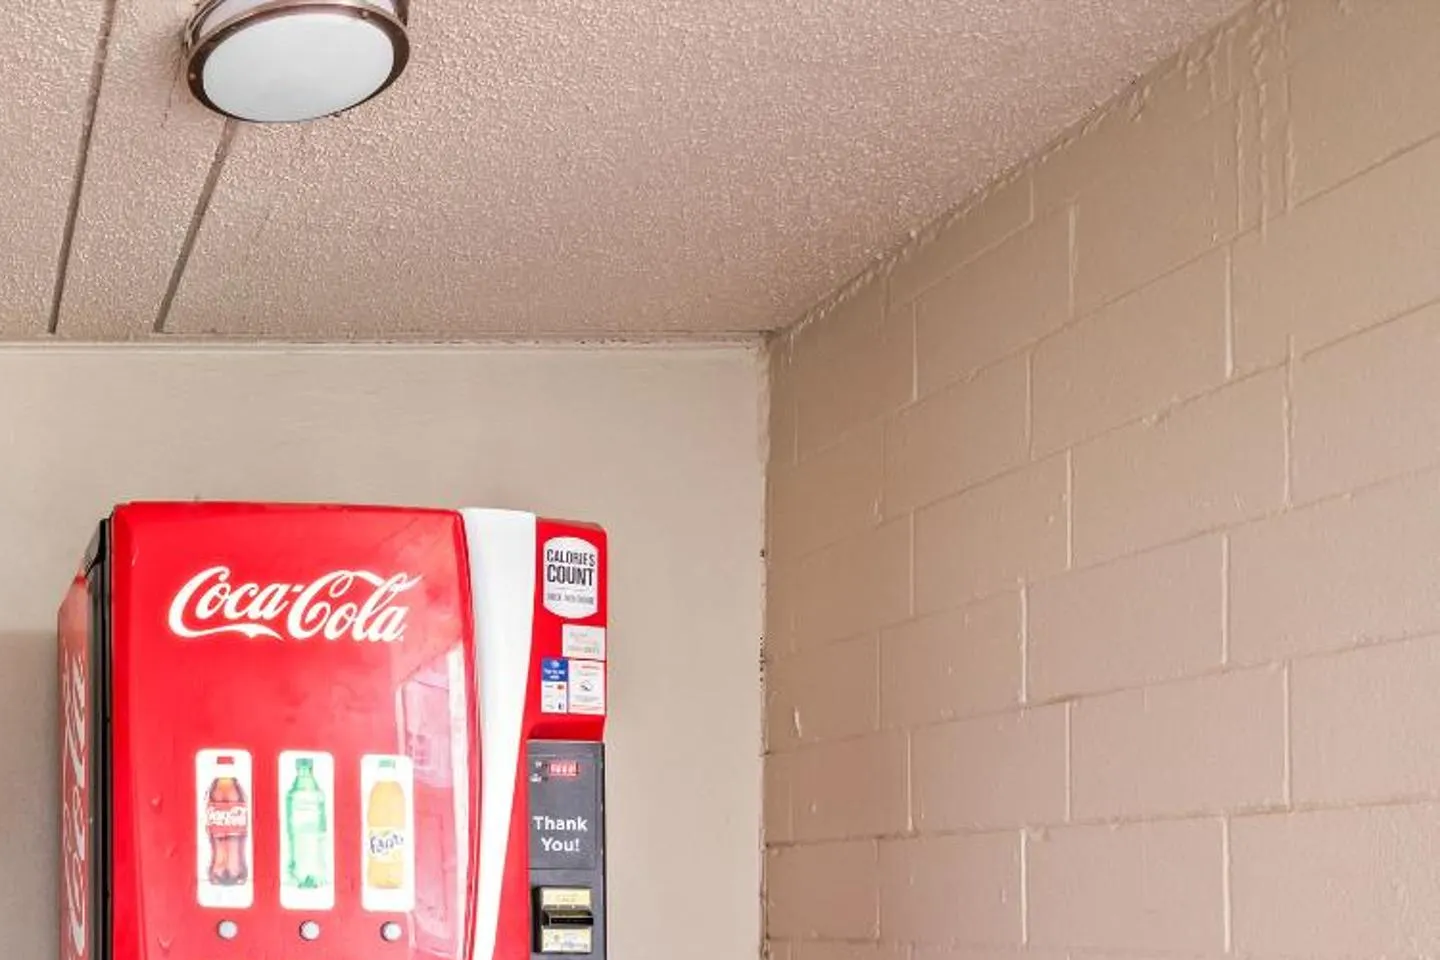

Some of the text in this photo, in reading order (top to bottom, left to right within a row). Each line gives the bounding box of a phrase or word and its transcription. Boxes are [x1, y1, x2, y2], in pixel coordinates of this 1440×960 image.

[546, 549, 596, 567] CALORIES
[546, 564, 595, 586] COUNT
[168, 566, 422, 642] Coca-Cola
[533, 816, 588, 832] Thank
[540, 837, 581, 852] You!
